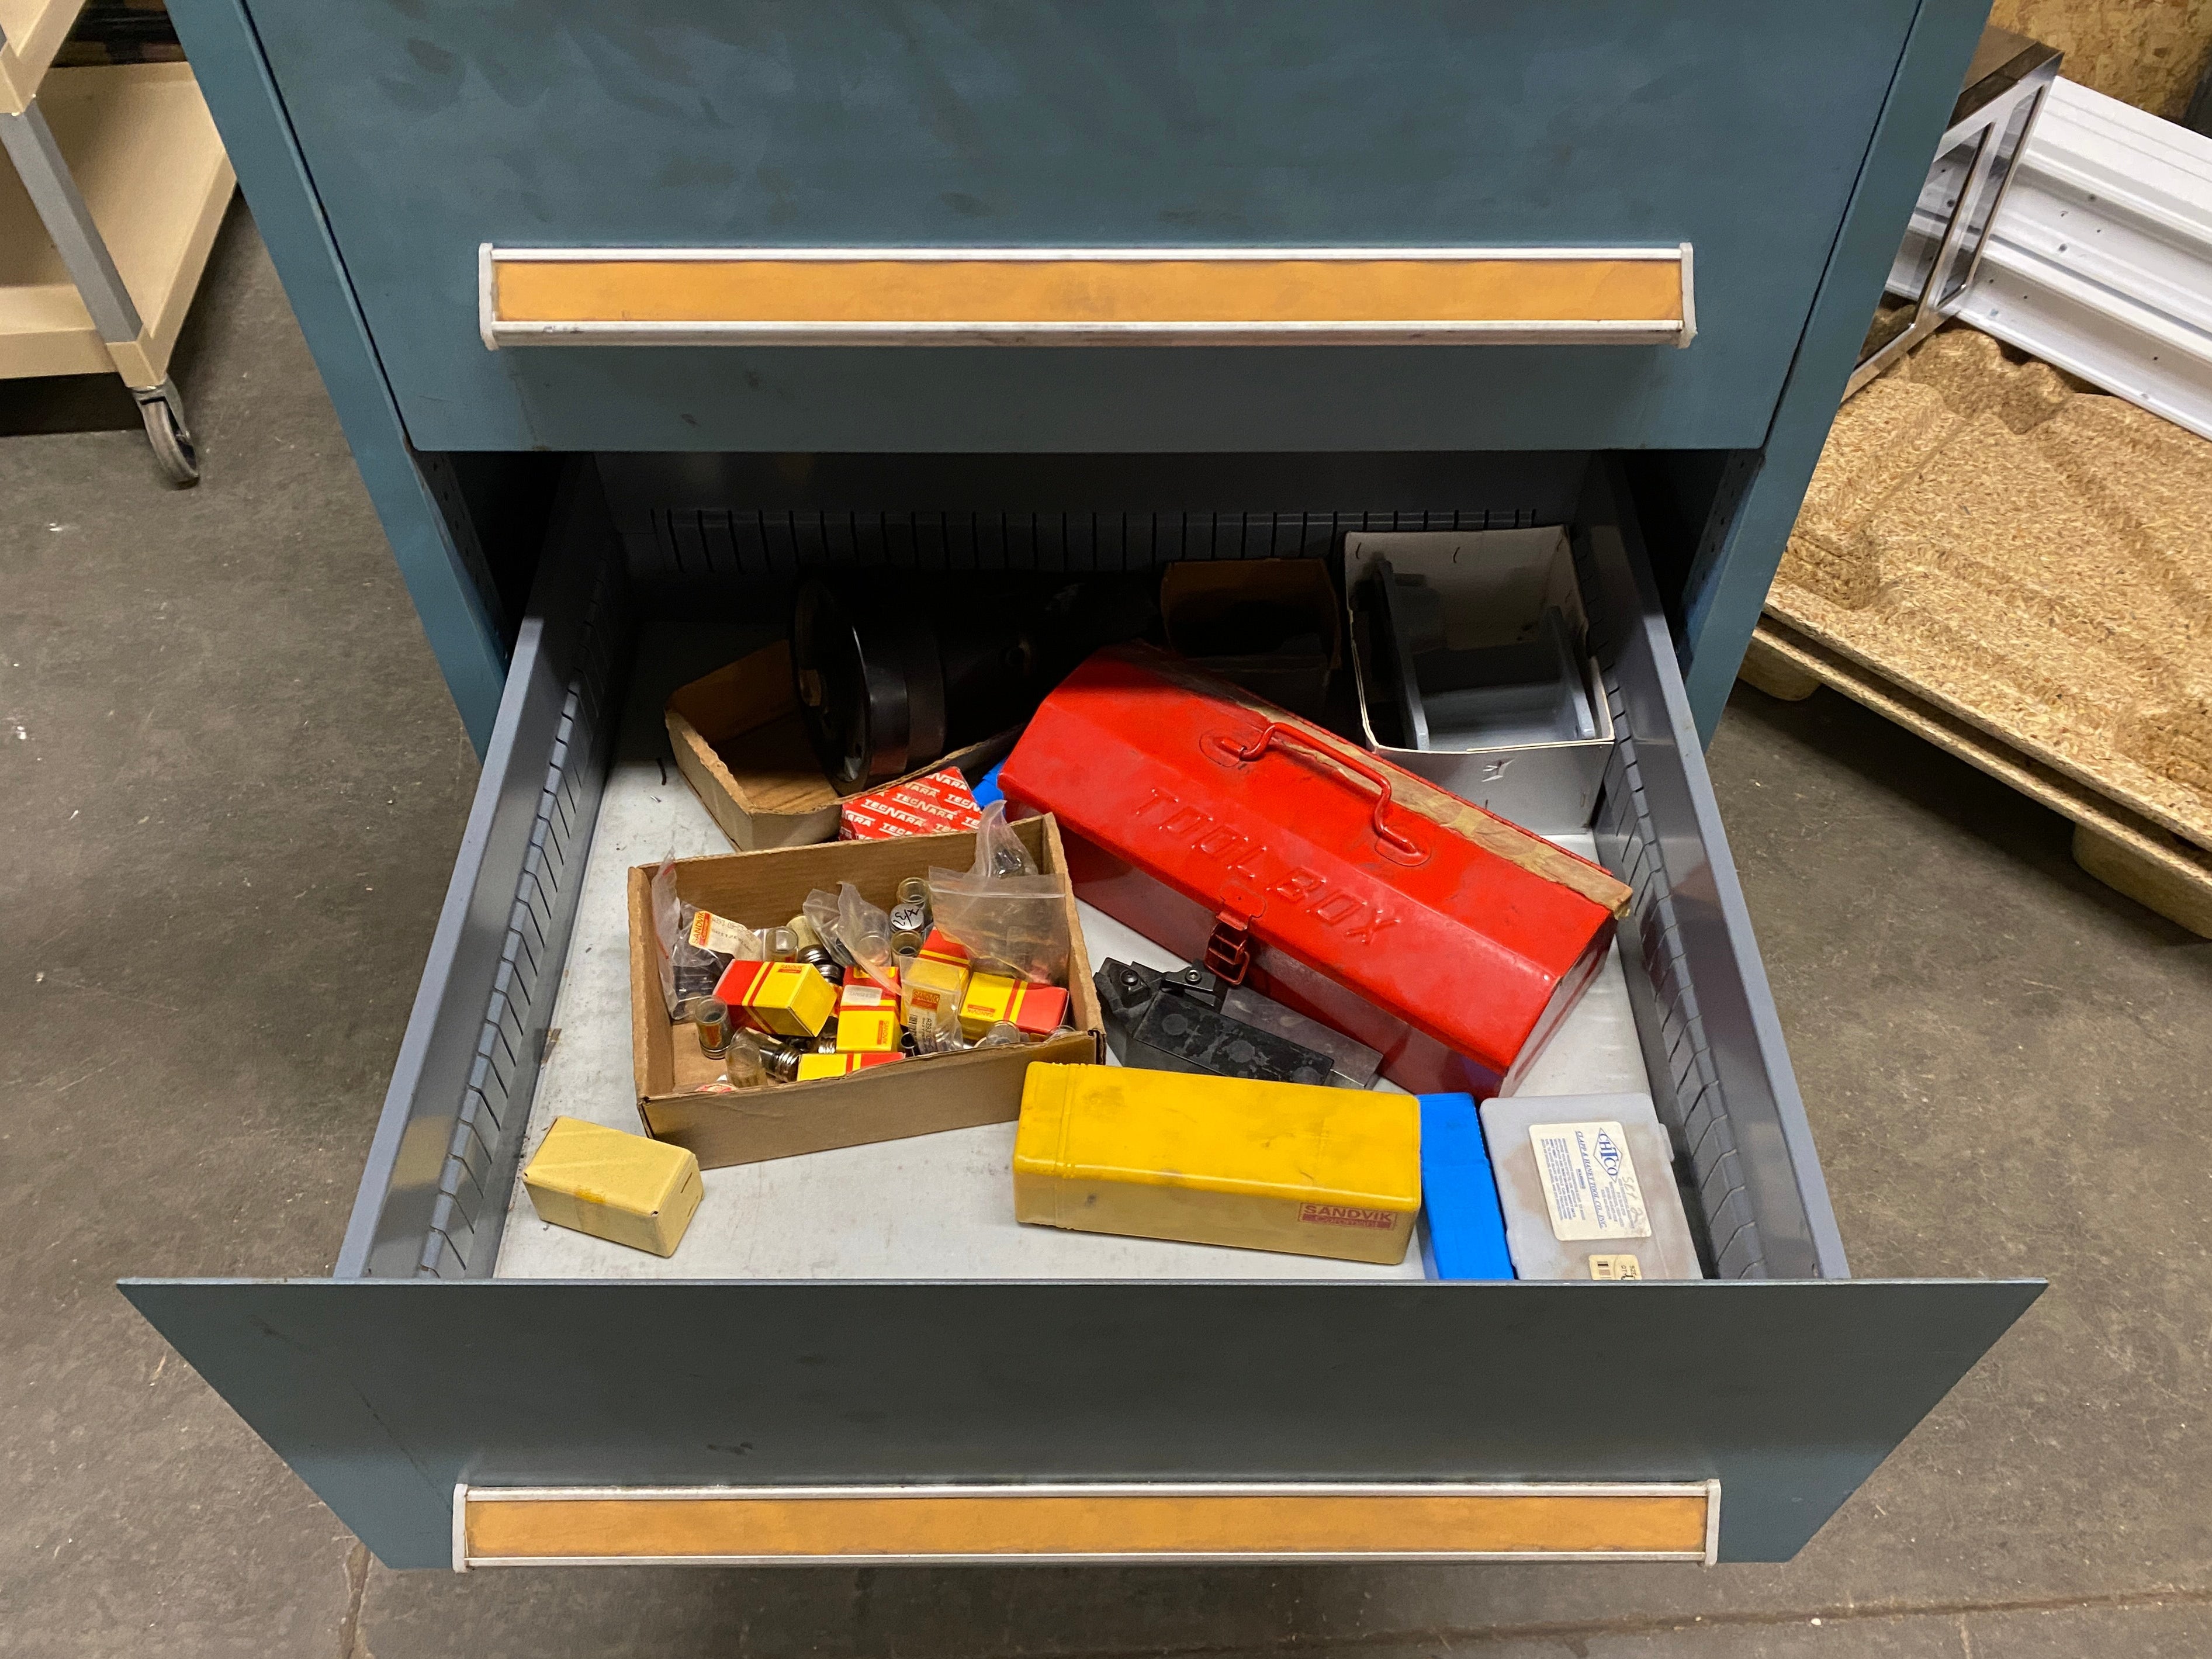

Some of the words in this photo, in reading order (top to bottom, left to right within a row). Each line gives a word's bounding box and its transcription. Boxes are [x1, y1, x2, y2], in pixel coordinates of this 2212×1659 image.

[861, 798, 927, 827] TECNARA
[892, 792, 958, 820] TECNARA
[1136, 788, 1266, 878] TOOL
[1267, 866, 1400, 944] BOX
[692, 912, 704, 944] SANDVIK
[1303, 1204, 1391, 1222] SANDVIK
